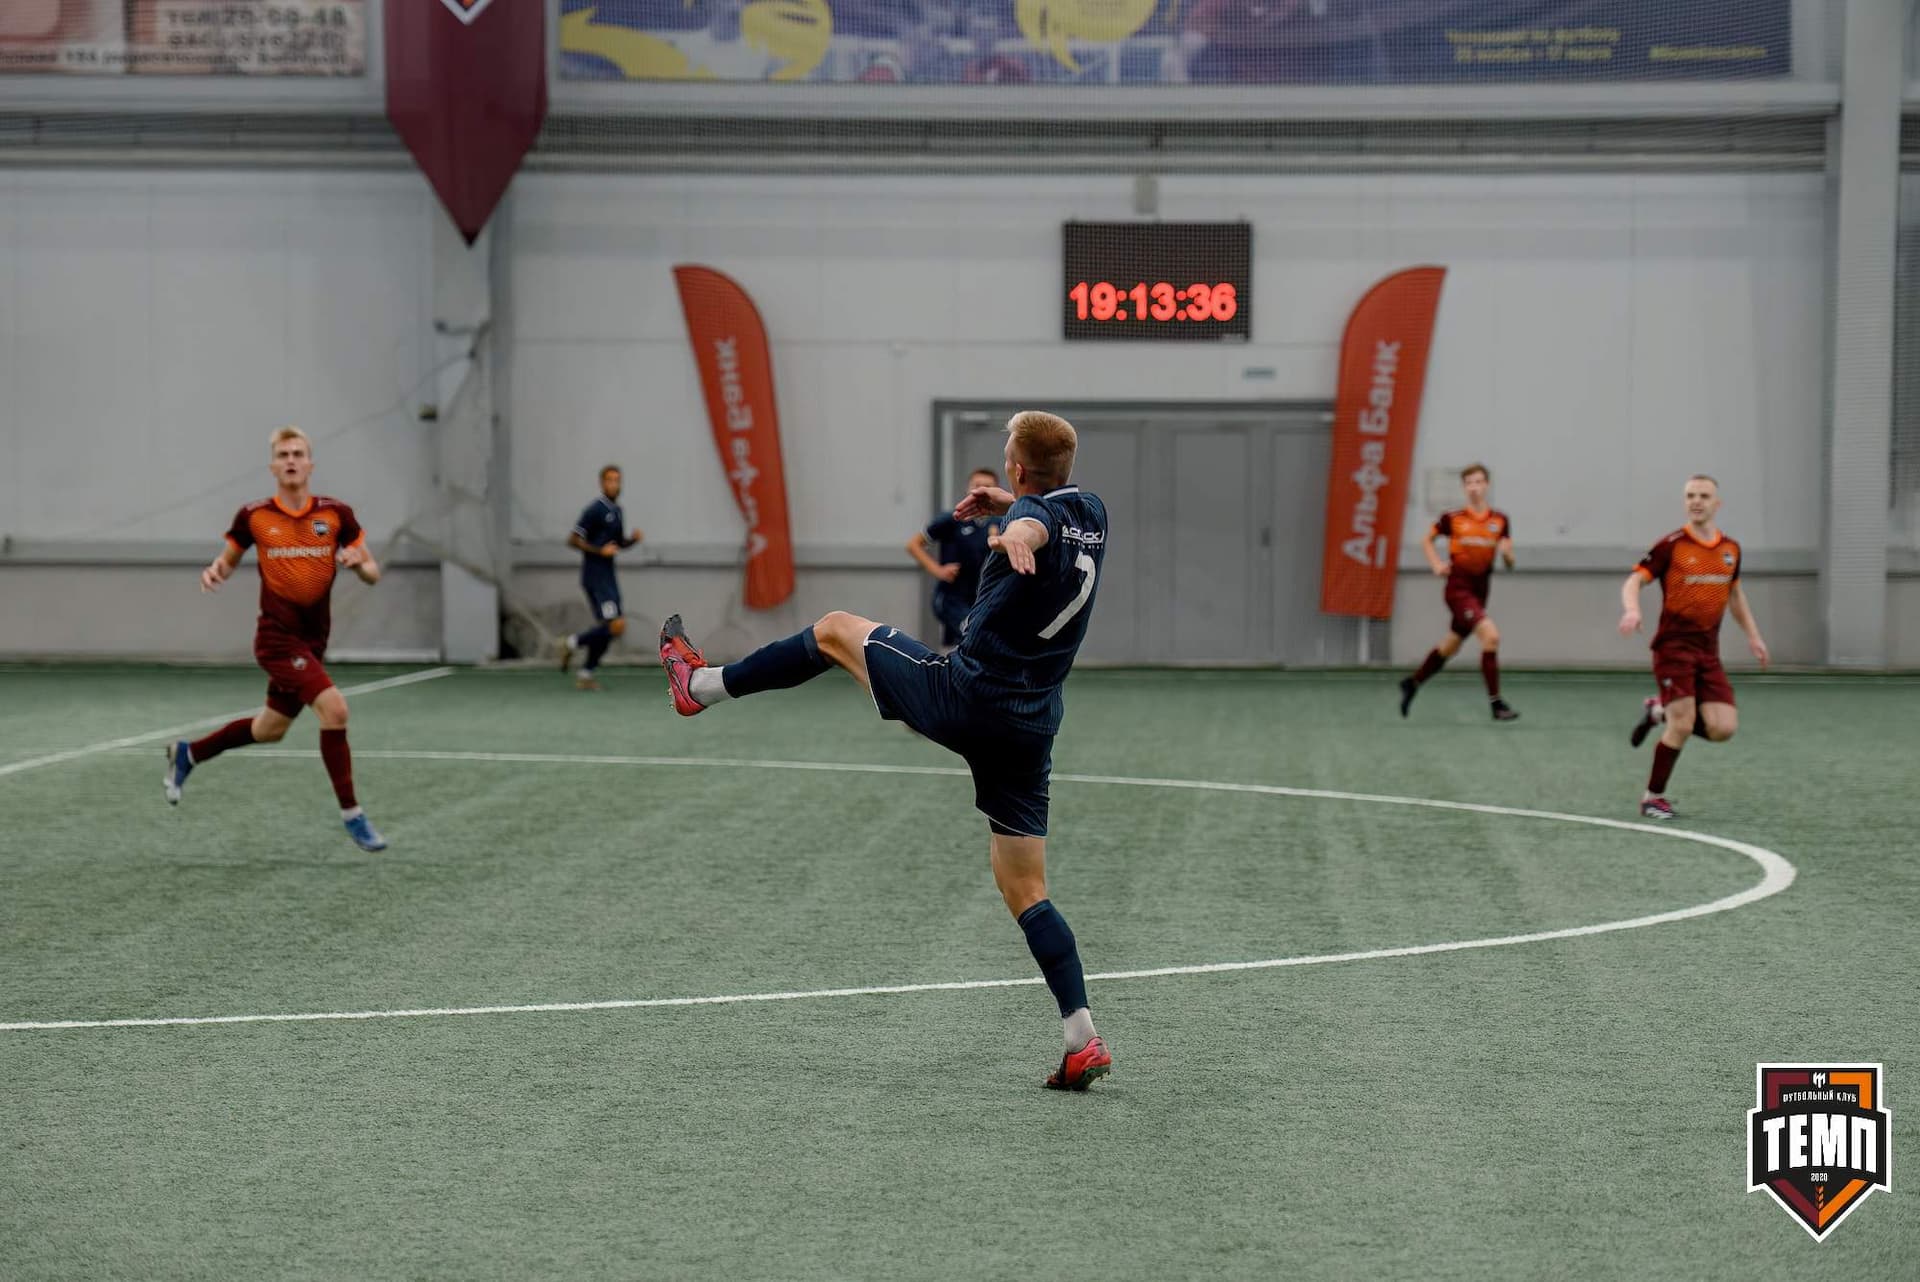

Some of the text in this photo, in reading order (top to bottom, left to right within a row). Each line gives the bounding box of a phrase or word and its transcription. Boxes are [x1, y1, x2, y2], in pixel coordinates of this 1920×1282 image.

[1069, 281, 1238, 321] 19:13:36
[1342, 339, 1402, 566] Альфа Банк
[1038, 551, 1097, 640] 7
